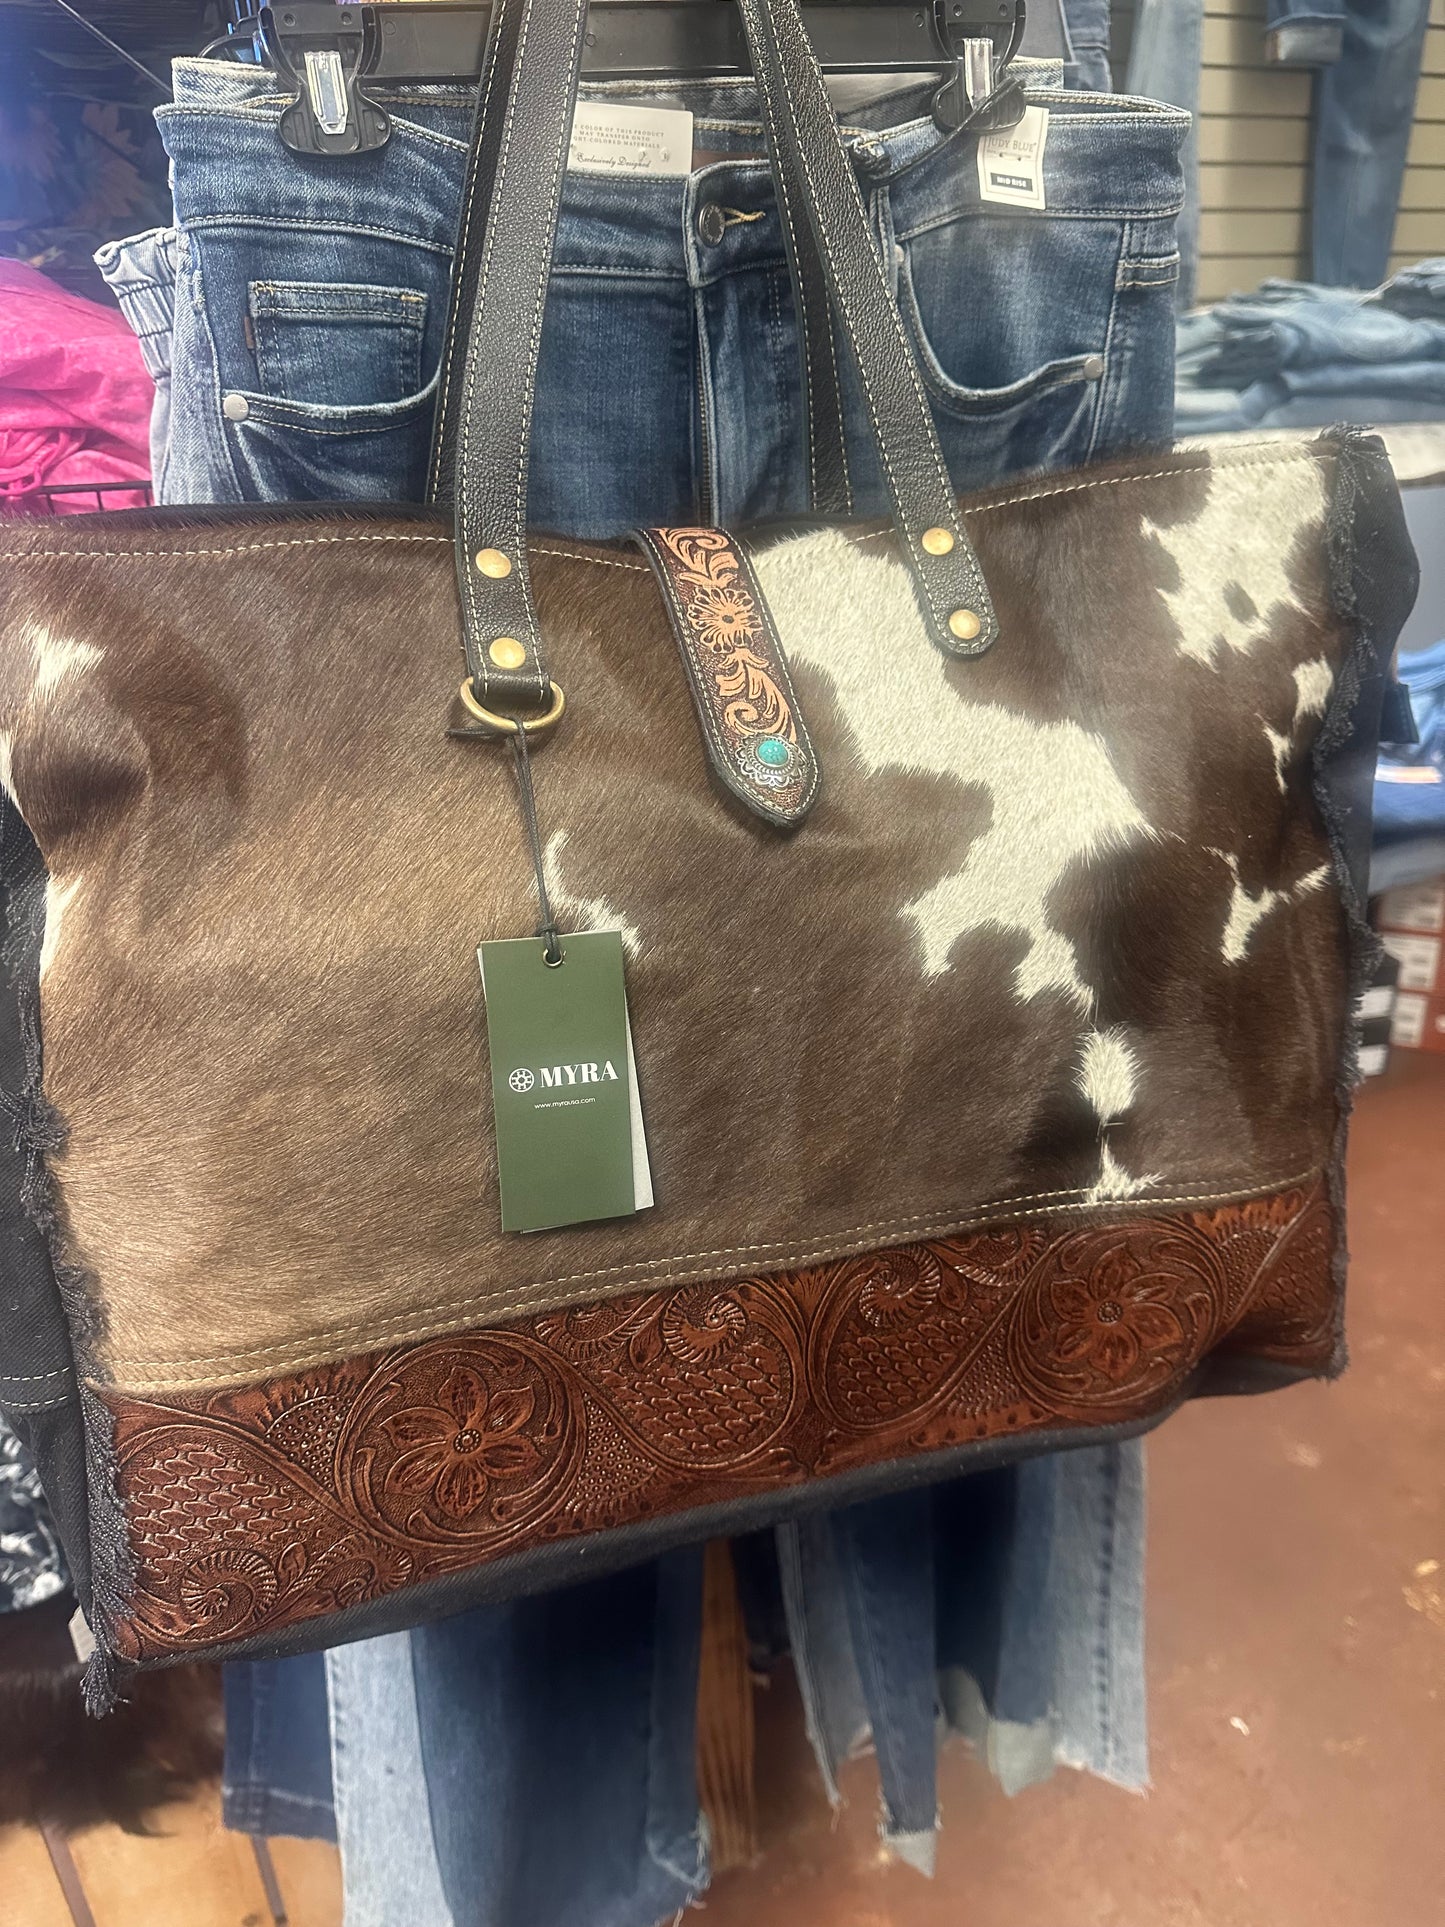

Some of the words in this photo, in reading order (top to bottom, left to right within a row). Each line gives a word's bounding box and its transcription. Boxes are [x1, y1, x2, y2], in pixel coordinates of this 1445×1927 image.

[579, 129, 594, 137] MAY
[596, 131, 630, 140] TRANSFER
[580, 124, 603, 132] COLOR
[616, 127, 632, 135] THIS
[633, 129, 665, 138] PRODUCT
[623, 140, 661, 149] MATERIALS
[987, 136, 1010, 148] JUDY
[576, 152, 617, 168] Exclusively
[617, 155, 652, 170] Designed
[996, 176, 1011, 185] MID
[1011, 178, 1027, 188] RISE
[539, 1060, 619, 1088] MYRA
[534, 1097, 596, 1109] www.myrausa.com
